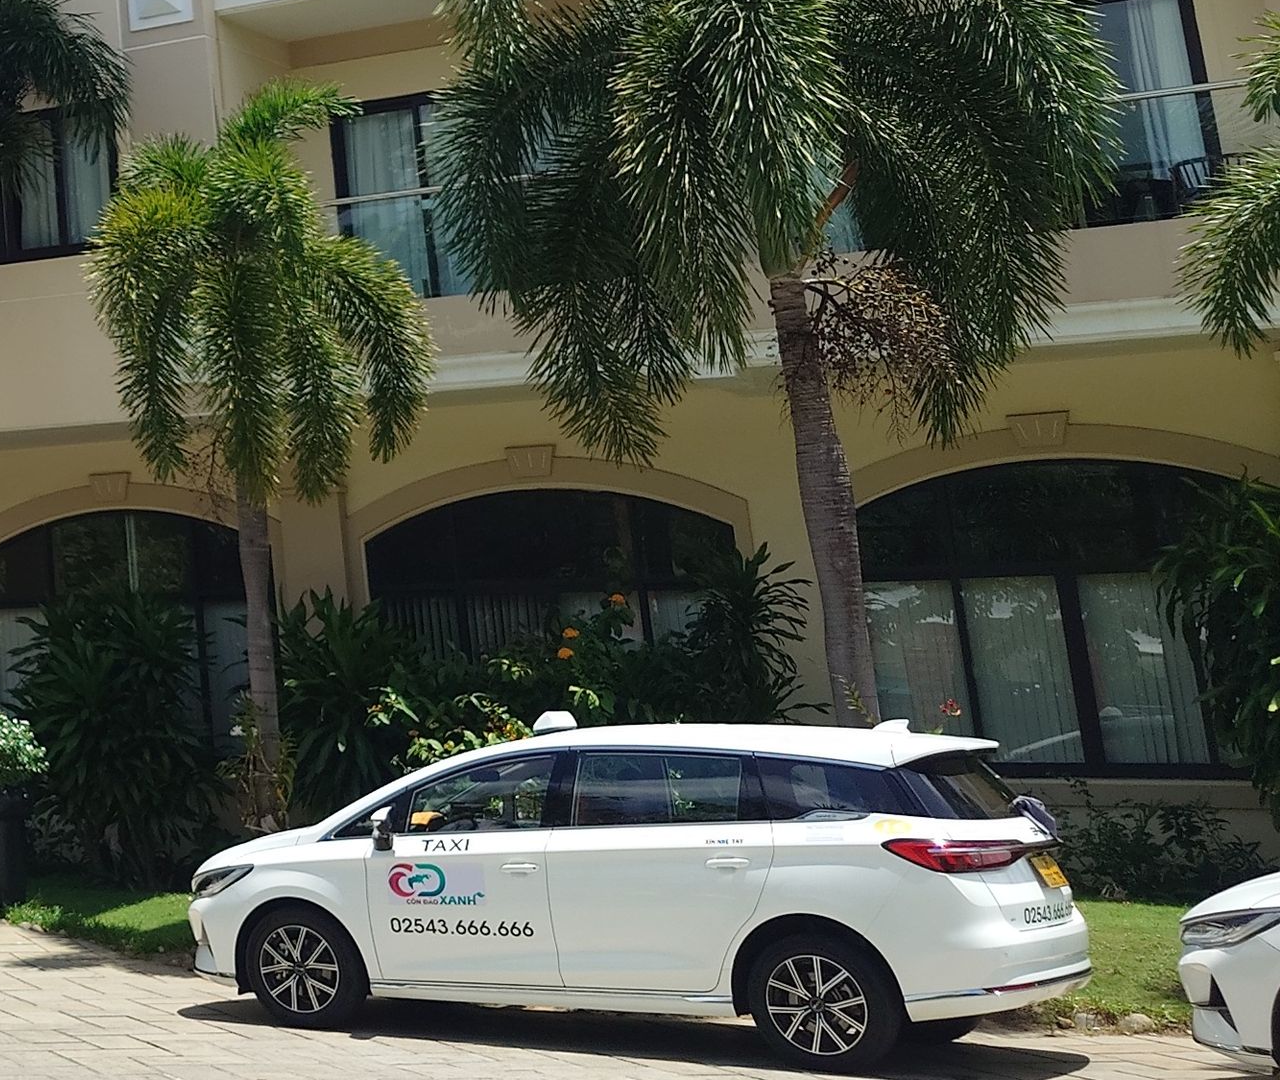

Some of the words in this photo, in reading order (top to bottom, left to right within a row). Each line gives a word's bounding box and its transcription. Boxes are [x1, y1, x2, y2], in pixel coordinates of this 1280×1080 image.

[422, 838, 470, 852] TAXI
[439, 893, 482, 905] XANH
[390, 917, 534, 937] 02543.666.666
